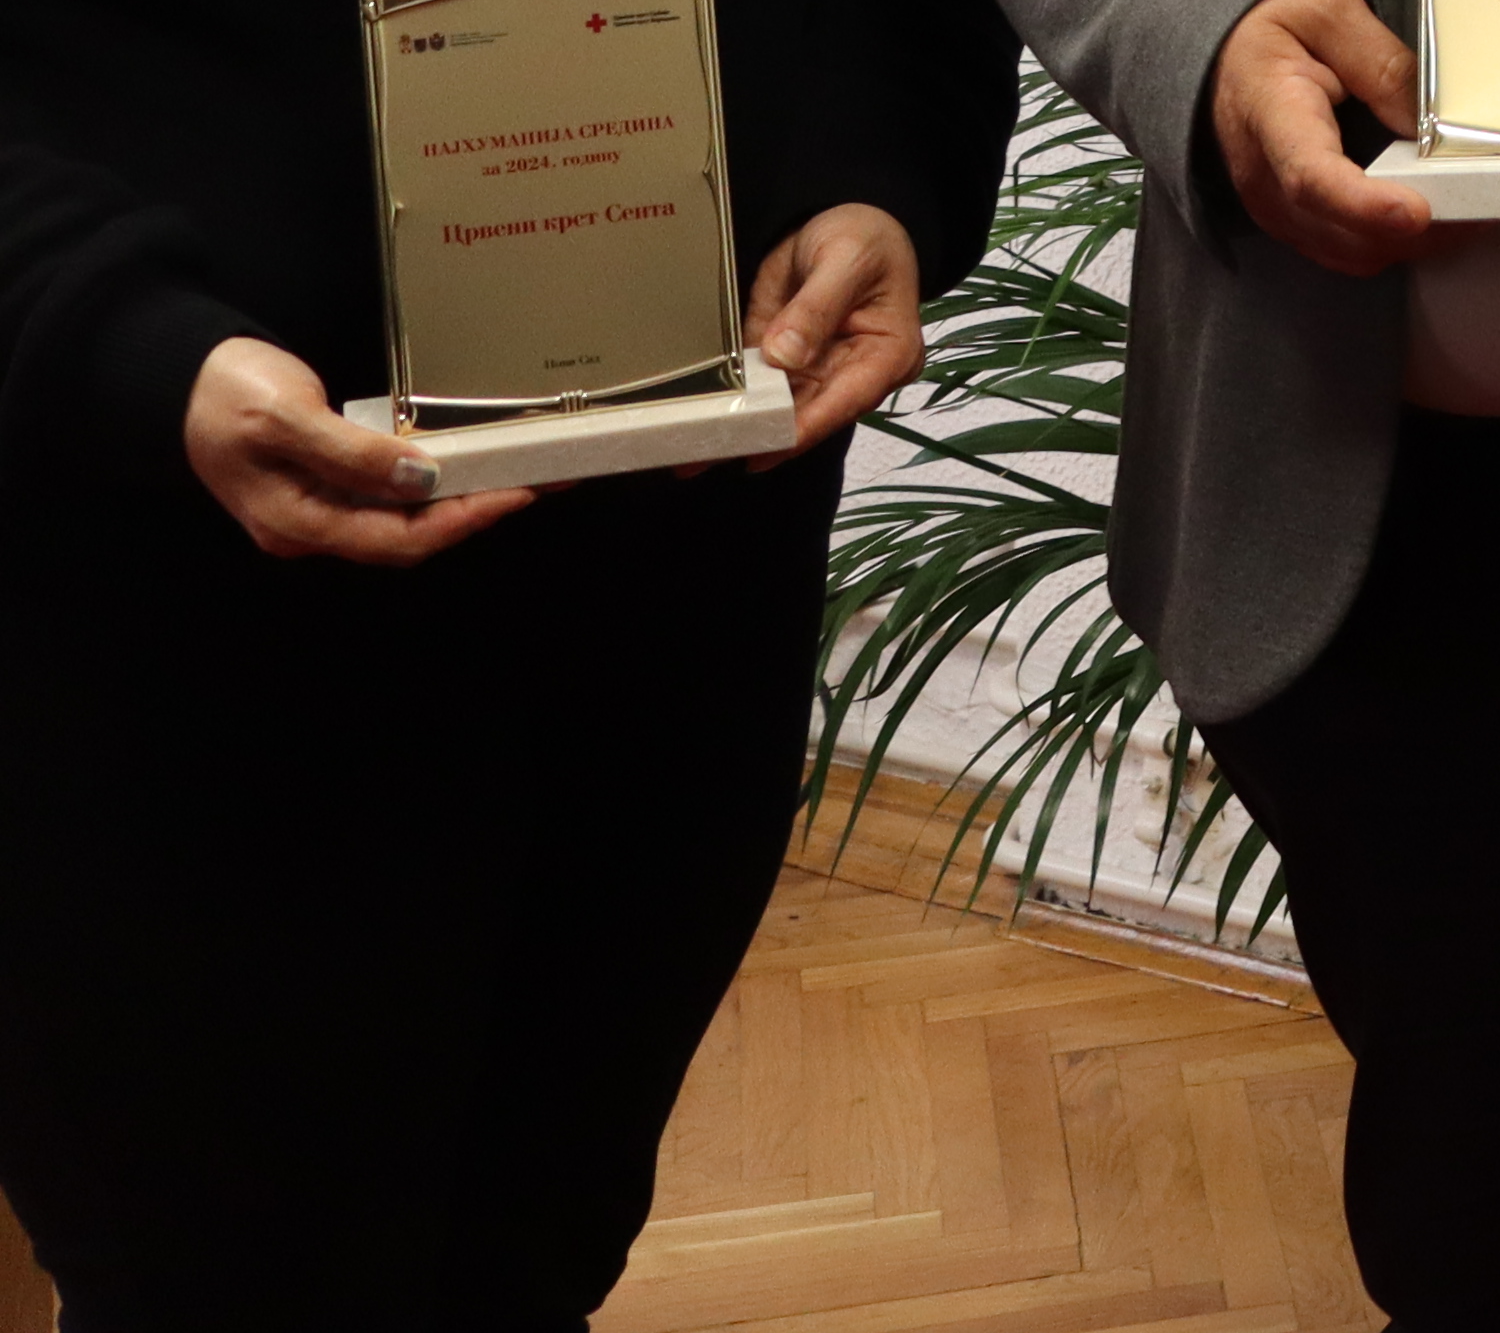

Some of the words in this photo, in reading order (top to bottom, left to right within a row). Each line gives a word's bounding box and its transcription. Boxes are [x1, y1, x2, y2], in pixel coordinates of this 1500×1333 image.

[423, 127, 577, 158] НАЈХУМАНИЈА
[578, 115, 675, 139] СРЕДИНА
[481, 164, 502, 177] за
[505, 155, 557, 174] 2024.
[561, 150, 620, 167] годину
[442, 219, 537, 247] Црвени
[543, 212, 597, 235] крст
[604, 202, 676, 223] Сента
